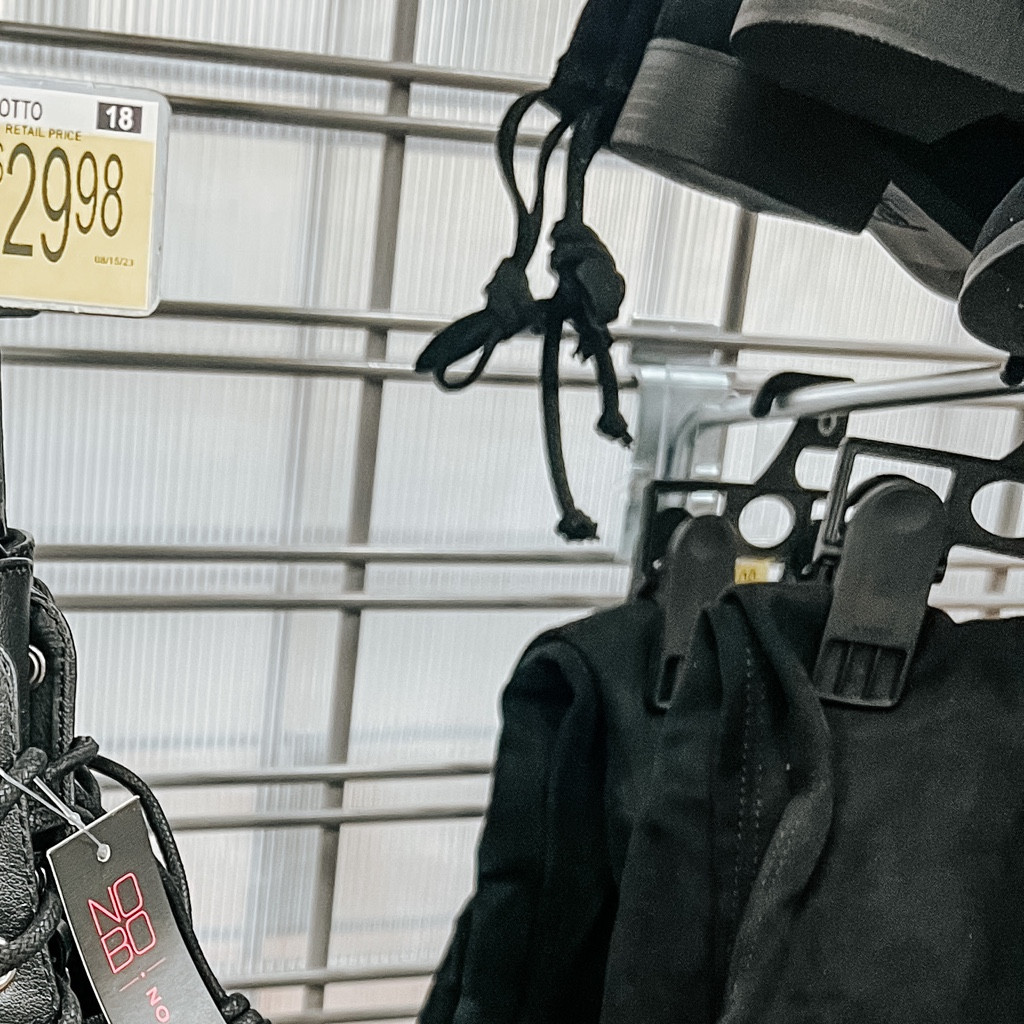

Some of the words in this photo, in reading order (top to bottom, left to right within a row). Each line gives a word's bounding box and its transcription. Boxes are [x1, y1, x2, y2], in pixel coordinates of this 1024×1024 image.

[105, 104, 134, 131] 18
[5, 124, 45, 138] RETAIL
[48, 129, 82, 142] PRICE
[145, 986, 171, 1023] NO
